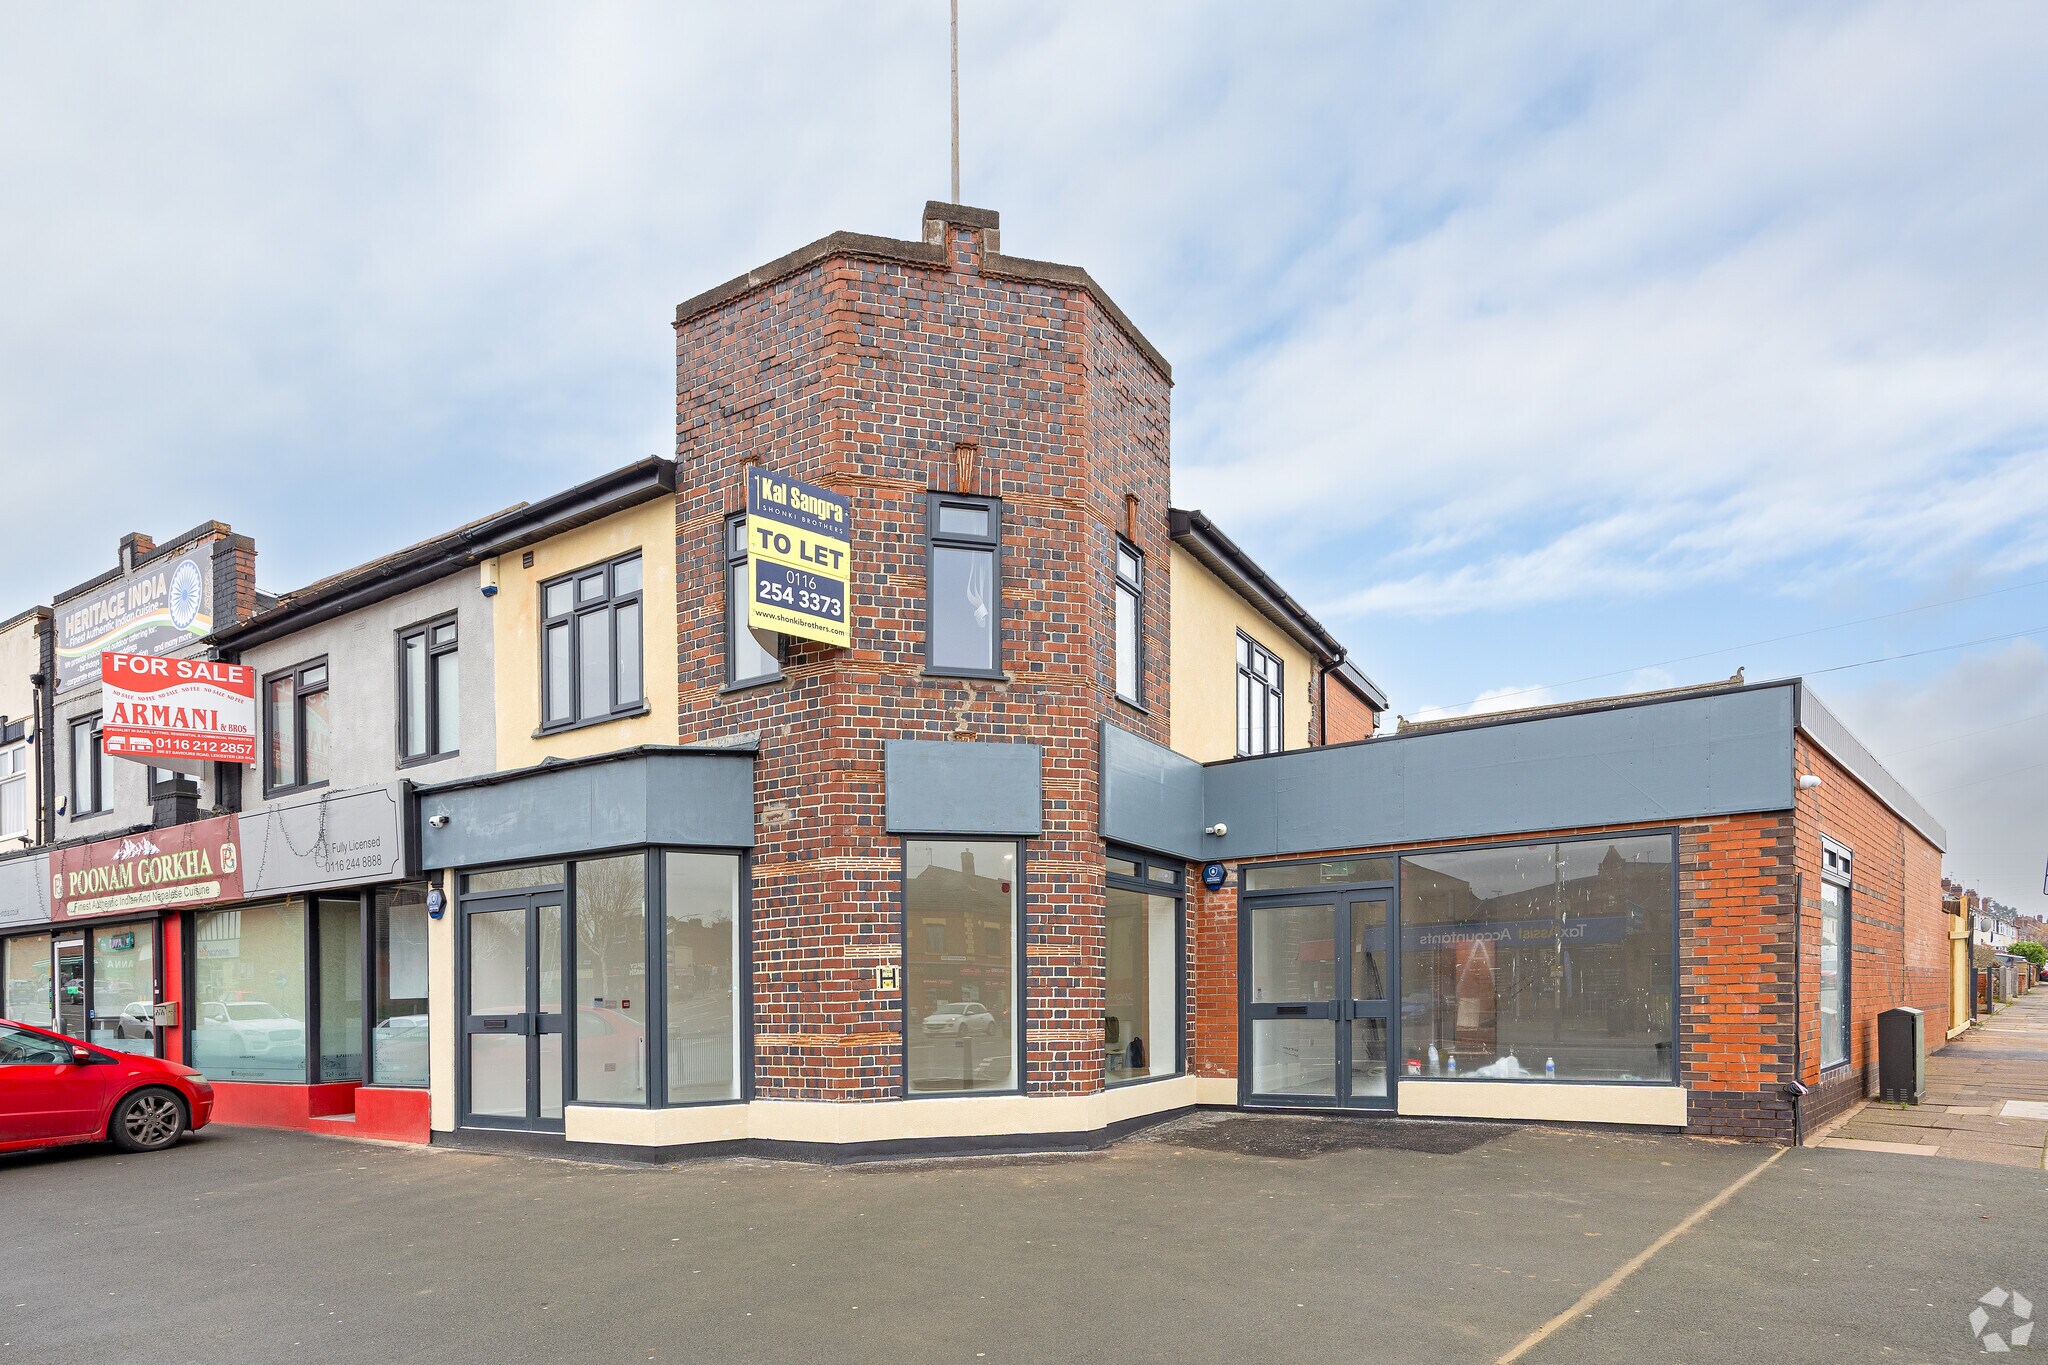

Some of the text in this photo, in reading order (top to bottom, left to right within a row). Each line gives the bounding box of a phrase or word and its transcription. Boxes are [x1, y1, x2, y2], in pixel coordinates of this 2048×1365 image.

[762, 477, 844, 523] Kal Sangra
[762, 505, 843, 534] SHONKI BROTHERS
[756, 528, 844, 570] TO LET
[786, 570, 816, 590] 0116
[65, 573, 167, 638] HERITAGE INDIA
[760, 580, 842, 616] 254 3373
[70, 634, 86, 648] Finest
[86, 621, 114, 640] Authentic
[115, 612, 134, 629] Indian
[135, 602, 158, 619] Cuisine
[755, 610, 844, 636] www.shonkibrothers.com
[70, 654, 86, 668] provide
[111, 635, 131, 652] outdoor
[131, 629, 148, 646] catering
[154, 642, 164, 652] and
[164, 636, 178, 652] many
[178, 632, 192, 642] more
[113, 654, 244, 684] FOR SALE
[121, 692, 134, 700] SALE
[166, 689, 179, 698] SALE
[212, 689, 225, 697] SALE
[111, 702, 247, 734] ARMANI & BROS
[155, 738, 190, 750] 0116
[192, 740, 218, 752] 212
[220, 743, 253, 754] 2857
[332, 836, 380, 854] Fully Licensed
[69, 862, 134, 896] POONAM
[138, 848, 213, 886] GORKHA
[326, 854, 382, 872] 0116 244 8888
[152, 886, 182, 902] Nepalese
[184, 885, 210, 898] Cuisine
